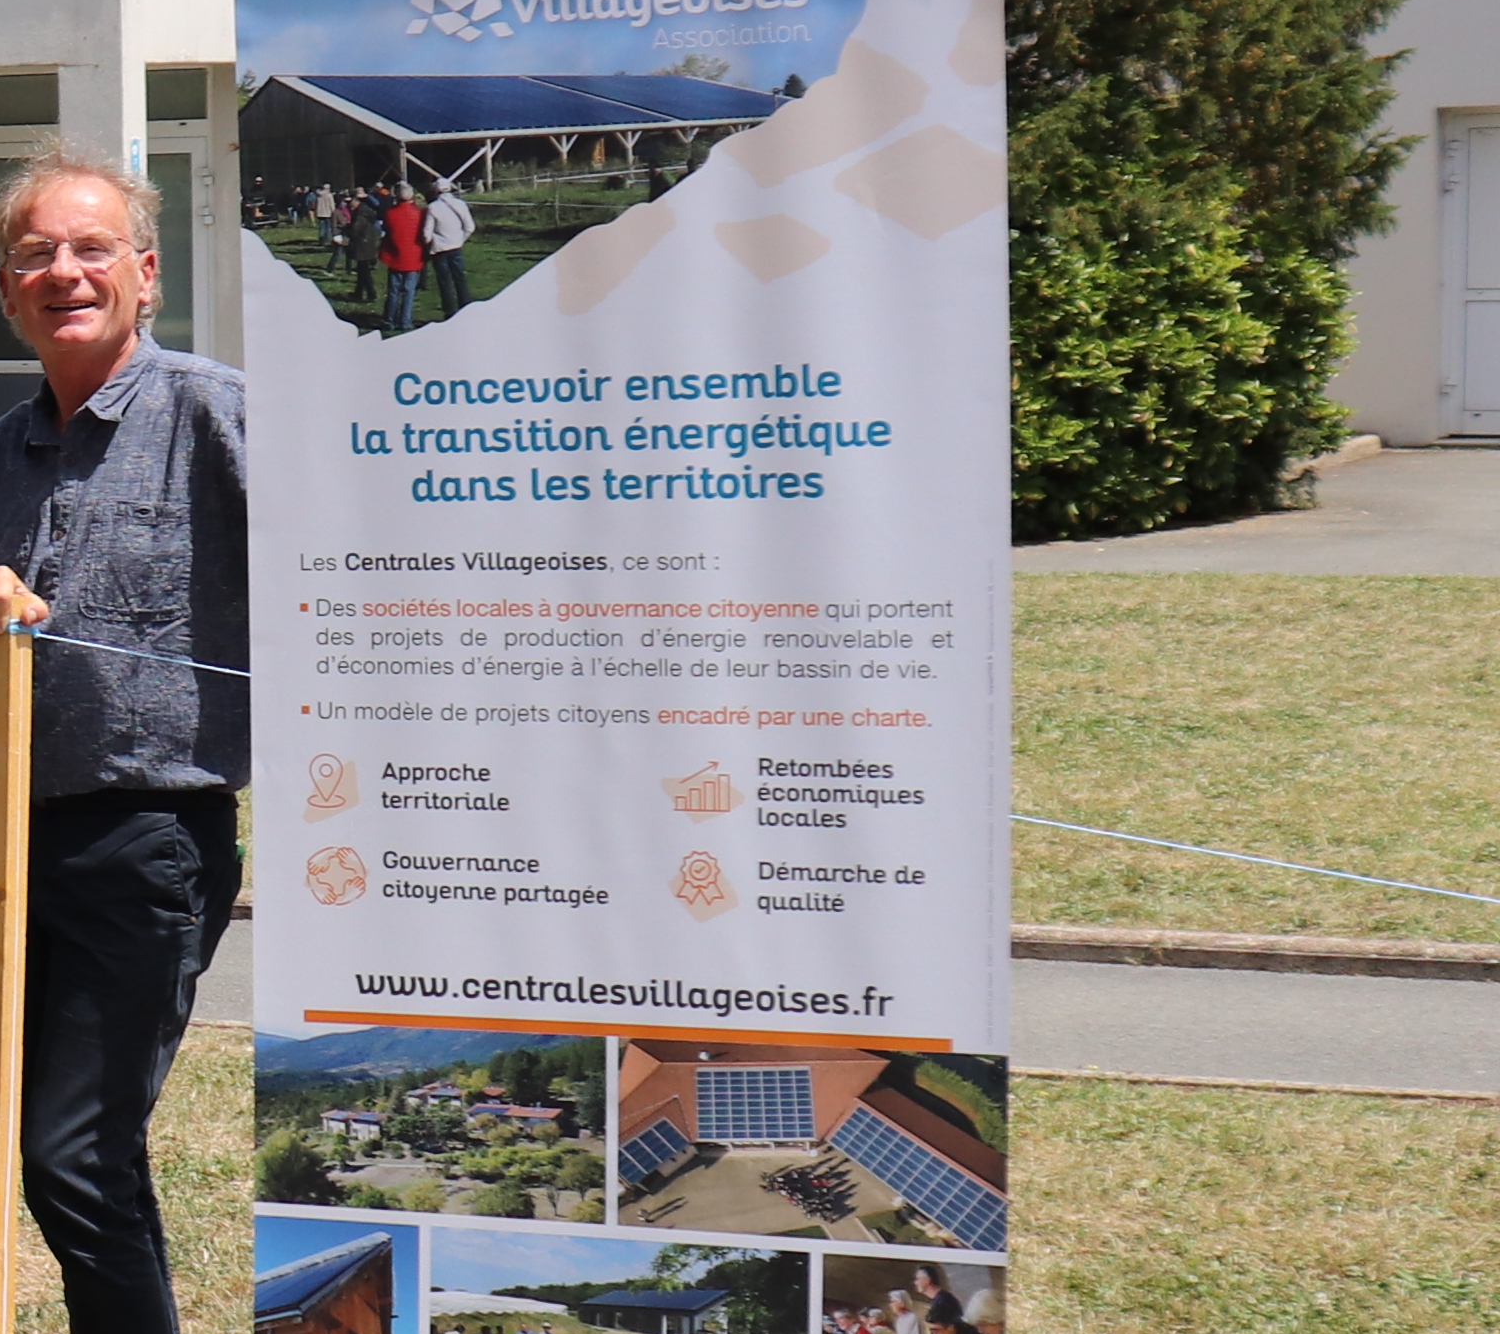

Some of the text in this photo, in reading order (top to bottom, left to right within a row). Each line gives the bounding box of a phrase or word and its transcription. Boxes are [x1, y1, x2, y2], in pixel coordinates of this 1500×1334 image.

[652, 19, 811, 53] Association
[393, 363, 842, 405] Concevoir ensemble
[351, 414, 893, 458] la transition énergétique
[410, 464, 825, 502] dans les territoires
[300, 551, 706, 575] Les Centrales Villageoises, ce sont
[316, 598, 954, 622] Des sociétés locales à gouvernance citoyenne qui portent
[316, 628, 954, 652] des projets de production d'énergie renouvelable et
[317, 656, 937, 680] d'économies d'énergie à l'échelle de leur bassin de vie.
[317, 702, 932, 729] Un modèle de projets citoyens encadré par une charte.
[381, 763, 491, 784] Approche
[758, 757, 894, 779] Retombées
[381, 791, 510, 811] territoriale
[757, 783, 925, 808] économiques
[757, 808, 847, 828] locales
[382, 851, 540, 873] Gouvernance
[758, 862, 925, 885] Démarche de
[382, 880, 609, 908] citoyenne partagée
[757, 892, 845, 915] qualité
[356, 973, 894, 1017] www.centralesvillageoises.fr
